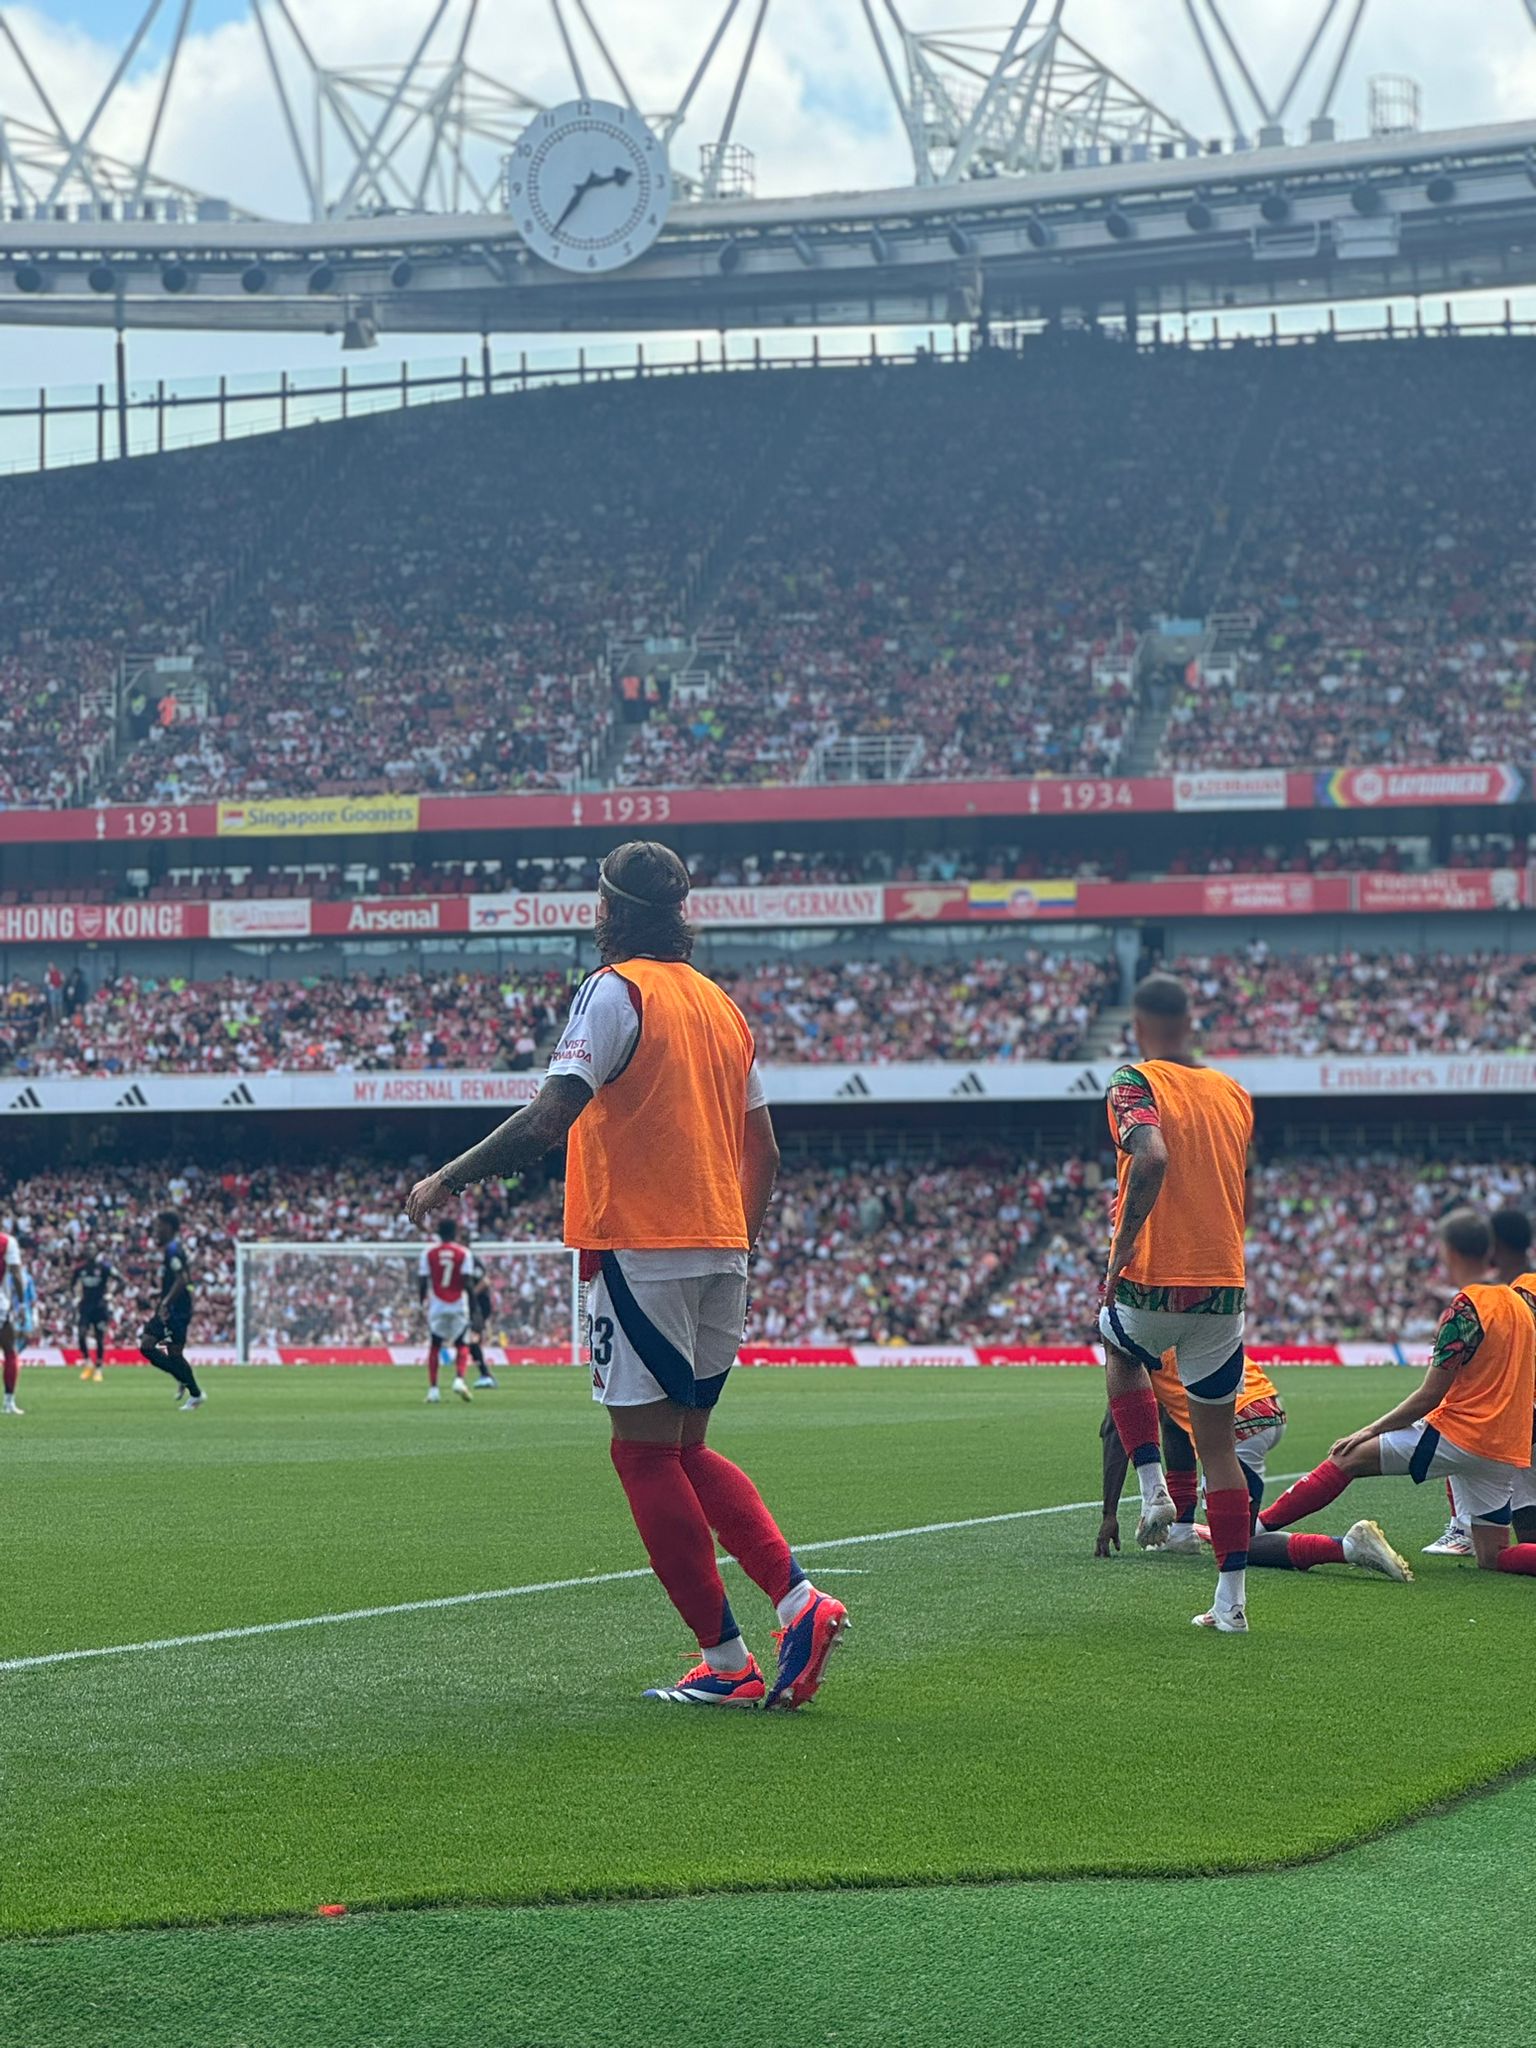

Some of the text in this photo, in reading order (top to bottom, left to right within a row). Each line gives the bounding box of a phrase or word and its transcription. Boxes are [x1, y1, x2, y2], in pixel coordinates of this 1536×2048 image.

[578, 102, 591, 116] 12
[618, 111, 625, 123] 1
[543, 115, 556, 128] 11
[517, 143, 533, 158] 10
[644, 137, 655, 151] 2
[511, 182, 522, 195] 9
[655, 176, 666, 190] 3
[524, 219, 534, 233] 8
[647, 213, 657, 226] 4
[551, 245, 561, 259] 7
[623, 243, 632, 256] 5
[587, 254, 597, 268] 6
[1061, 783, 1133, 809] 1934
[248, 804, 414, 828] Singapore Gooners
[602, 796, 670, 821] 1933
[125, 811, 188, 835] 1931
[513, 898, 600, 926] Slove
[785, 890, 876, 917] GERMANY
[7, 906, 74, 939] HONG
[106, 905, 173, 936] KONG
[348, 902, 439, 932] Arsenal
[1320, 1064, 1438, 1089] Emirates
[354, 1078, 540, 1101] MY ARSENAL REWARDS
[440, 1259, 454, 1288] 7
[588, 1314, 615, 1366] 3
